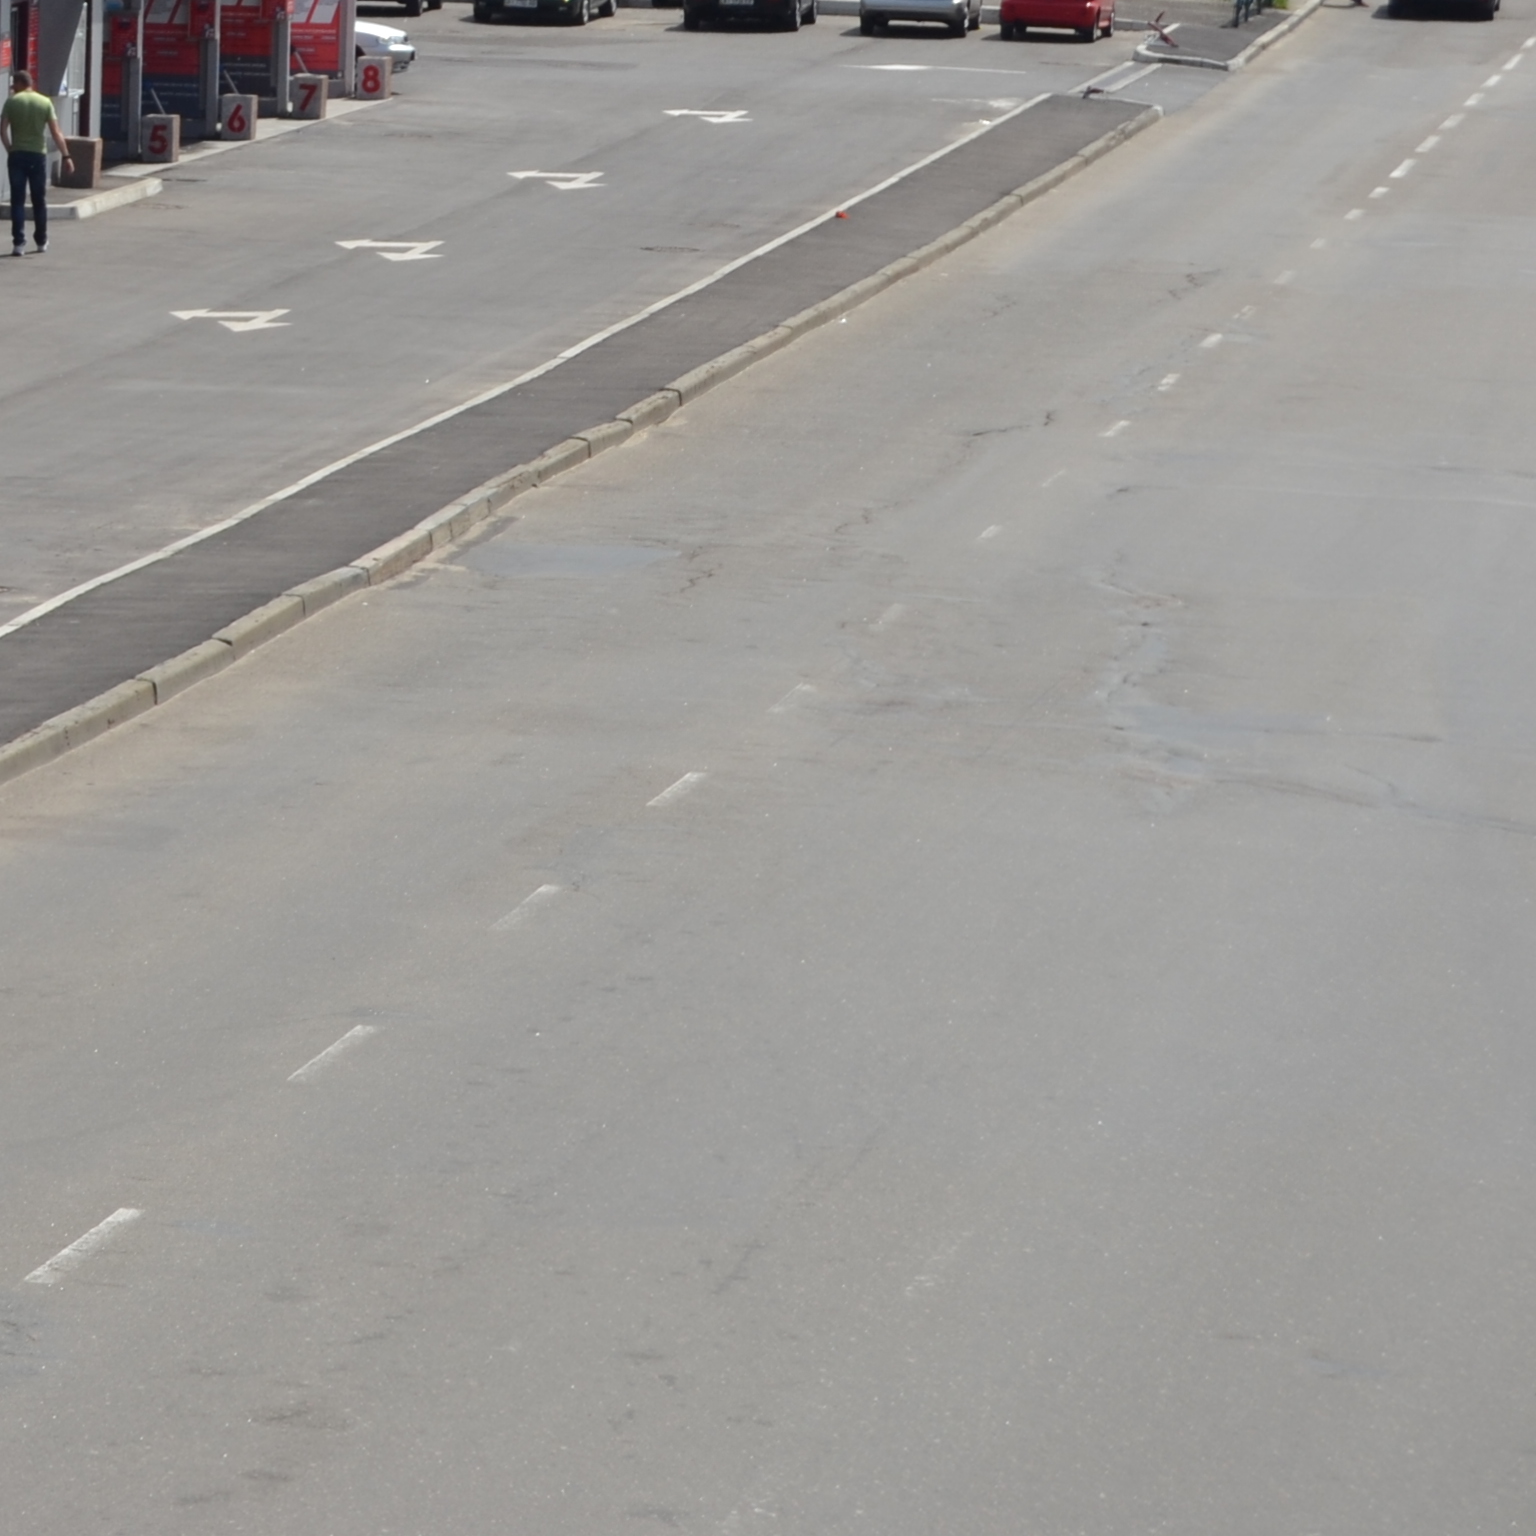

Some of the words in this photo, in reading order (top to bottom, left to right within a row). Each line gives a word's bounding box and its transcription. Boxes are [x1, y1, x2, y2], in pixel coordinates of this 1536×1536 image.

[362, 65, 381, 94] 8
[299, 84, 318, 112] 7
[227, 102, 247, 133] 6
[147, 124, 169, 155] 5
